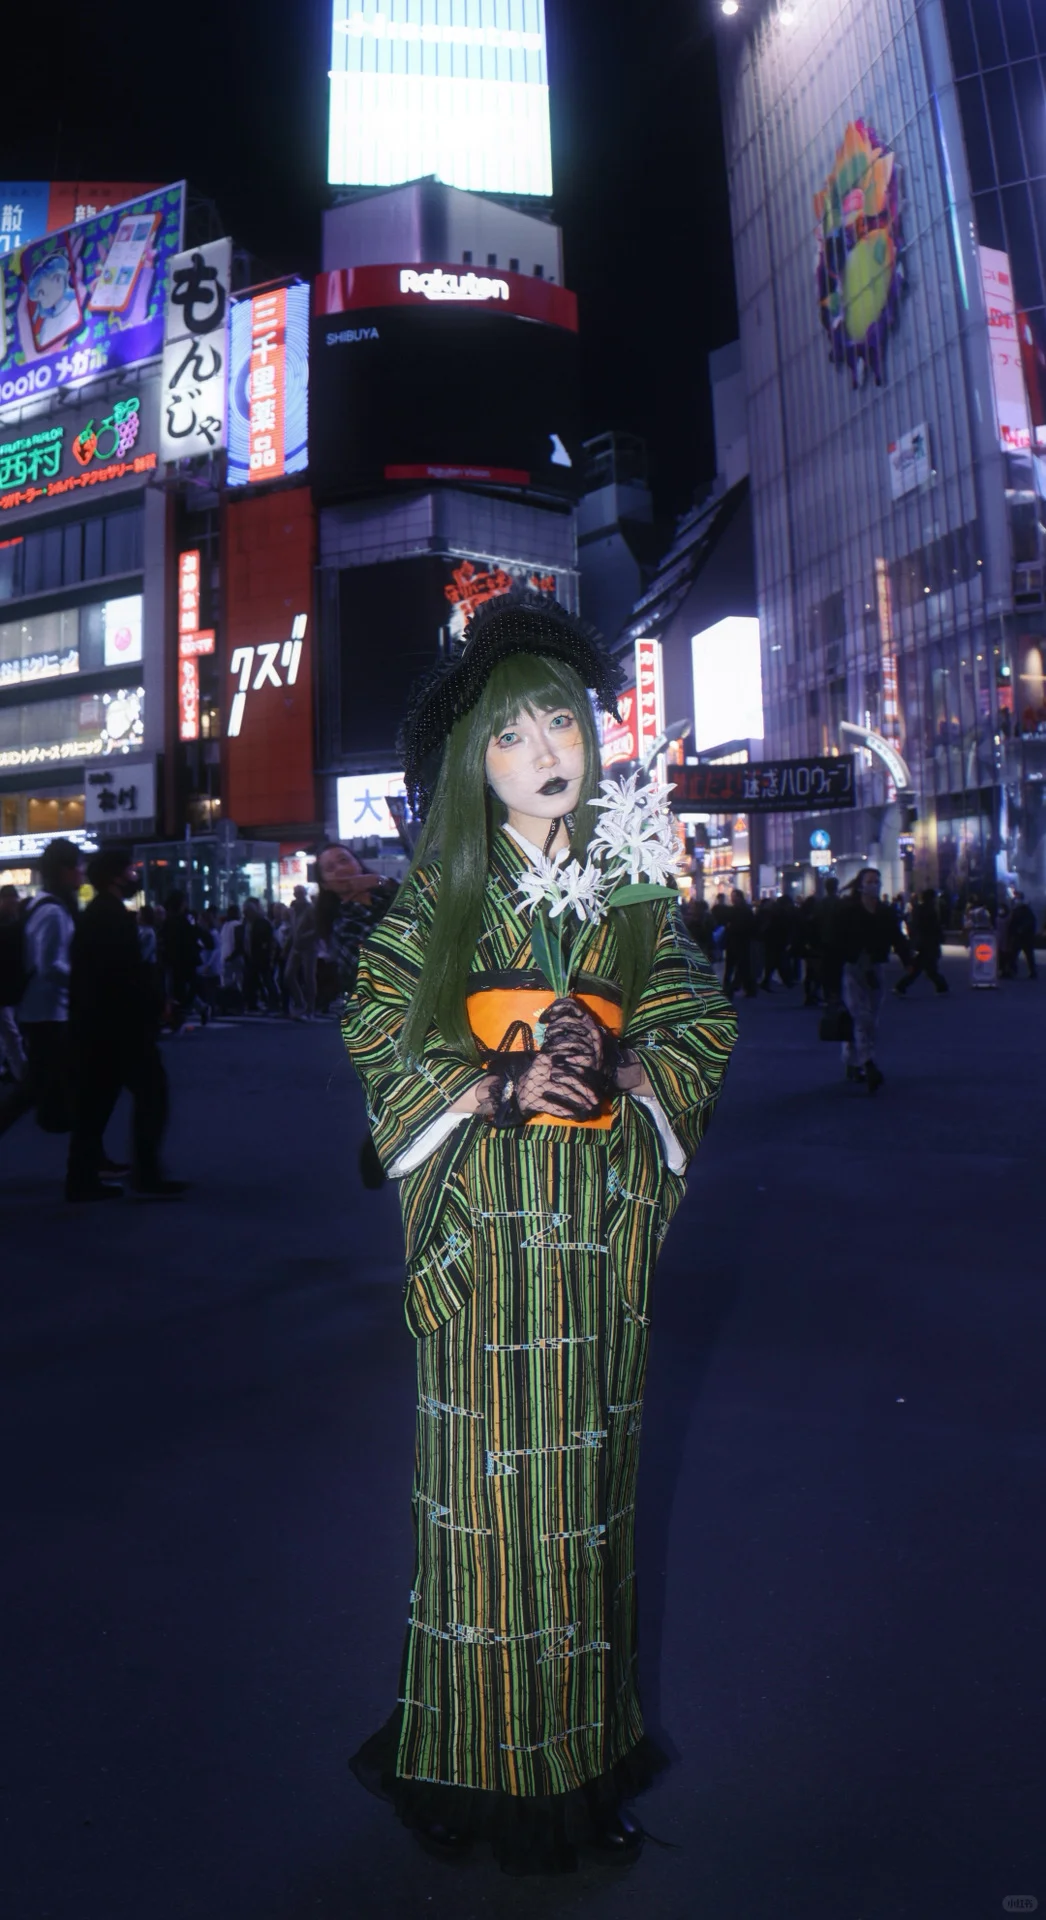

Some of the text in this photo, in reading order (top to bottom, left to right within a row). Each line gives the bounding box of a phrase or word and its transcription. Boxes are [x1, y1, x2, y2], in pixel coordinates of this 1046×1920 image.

[400, 268, 509, 301] Rakuten
[167, 254, 227, 445] もんじゃ
[327, 327, 379, 345] SHIBUYA
[250, 297, 278, 469] 三千里薬品
[0, 440, 62, 488] 西村
